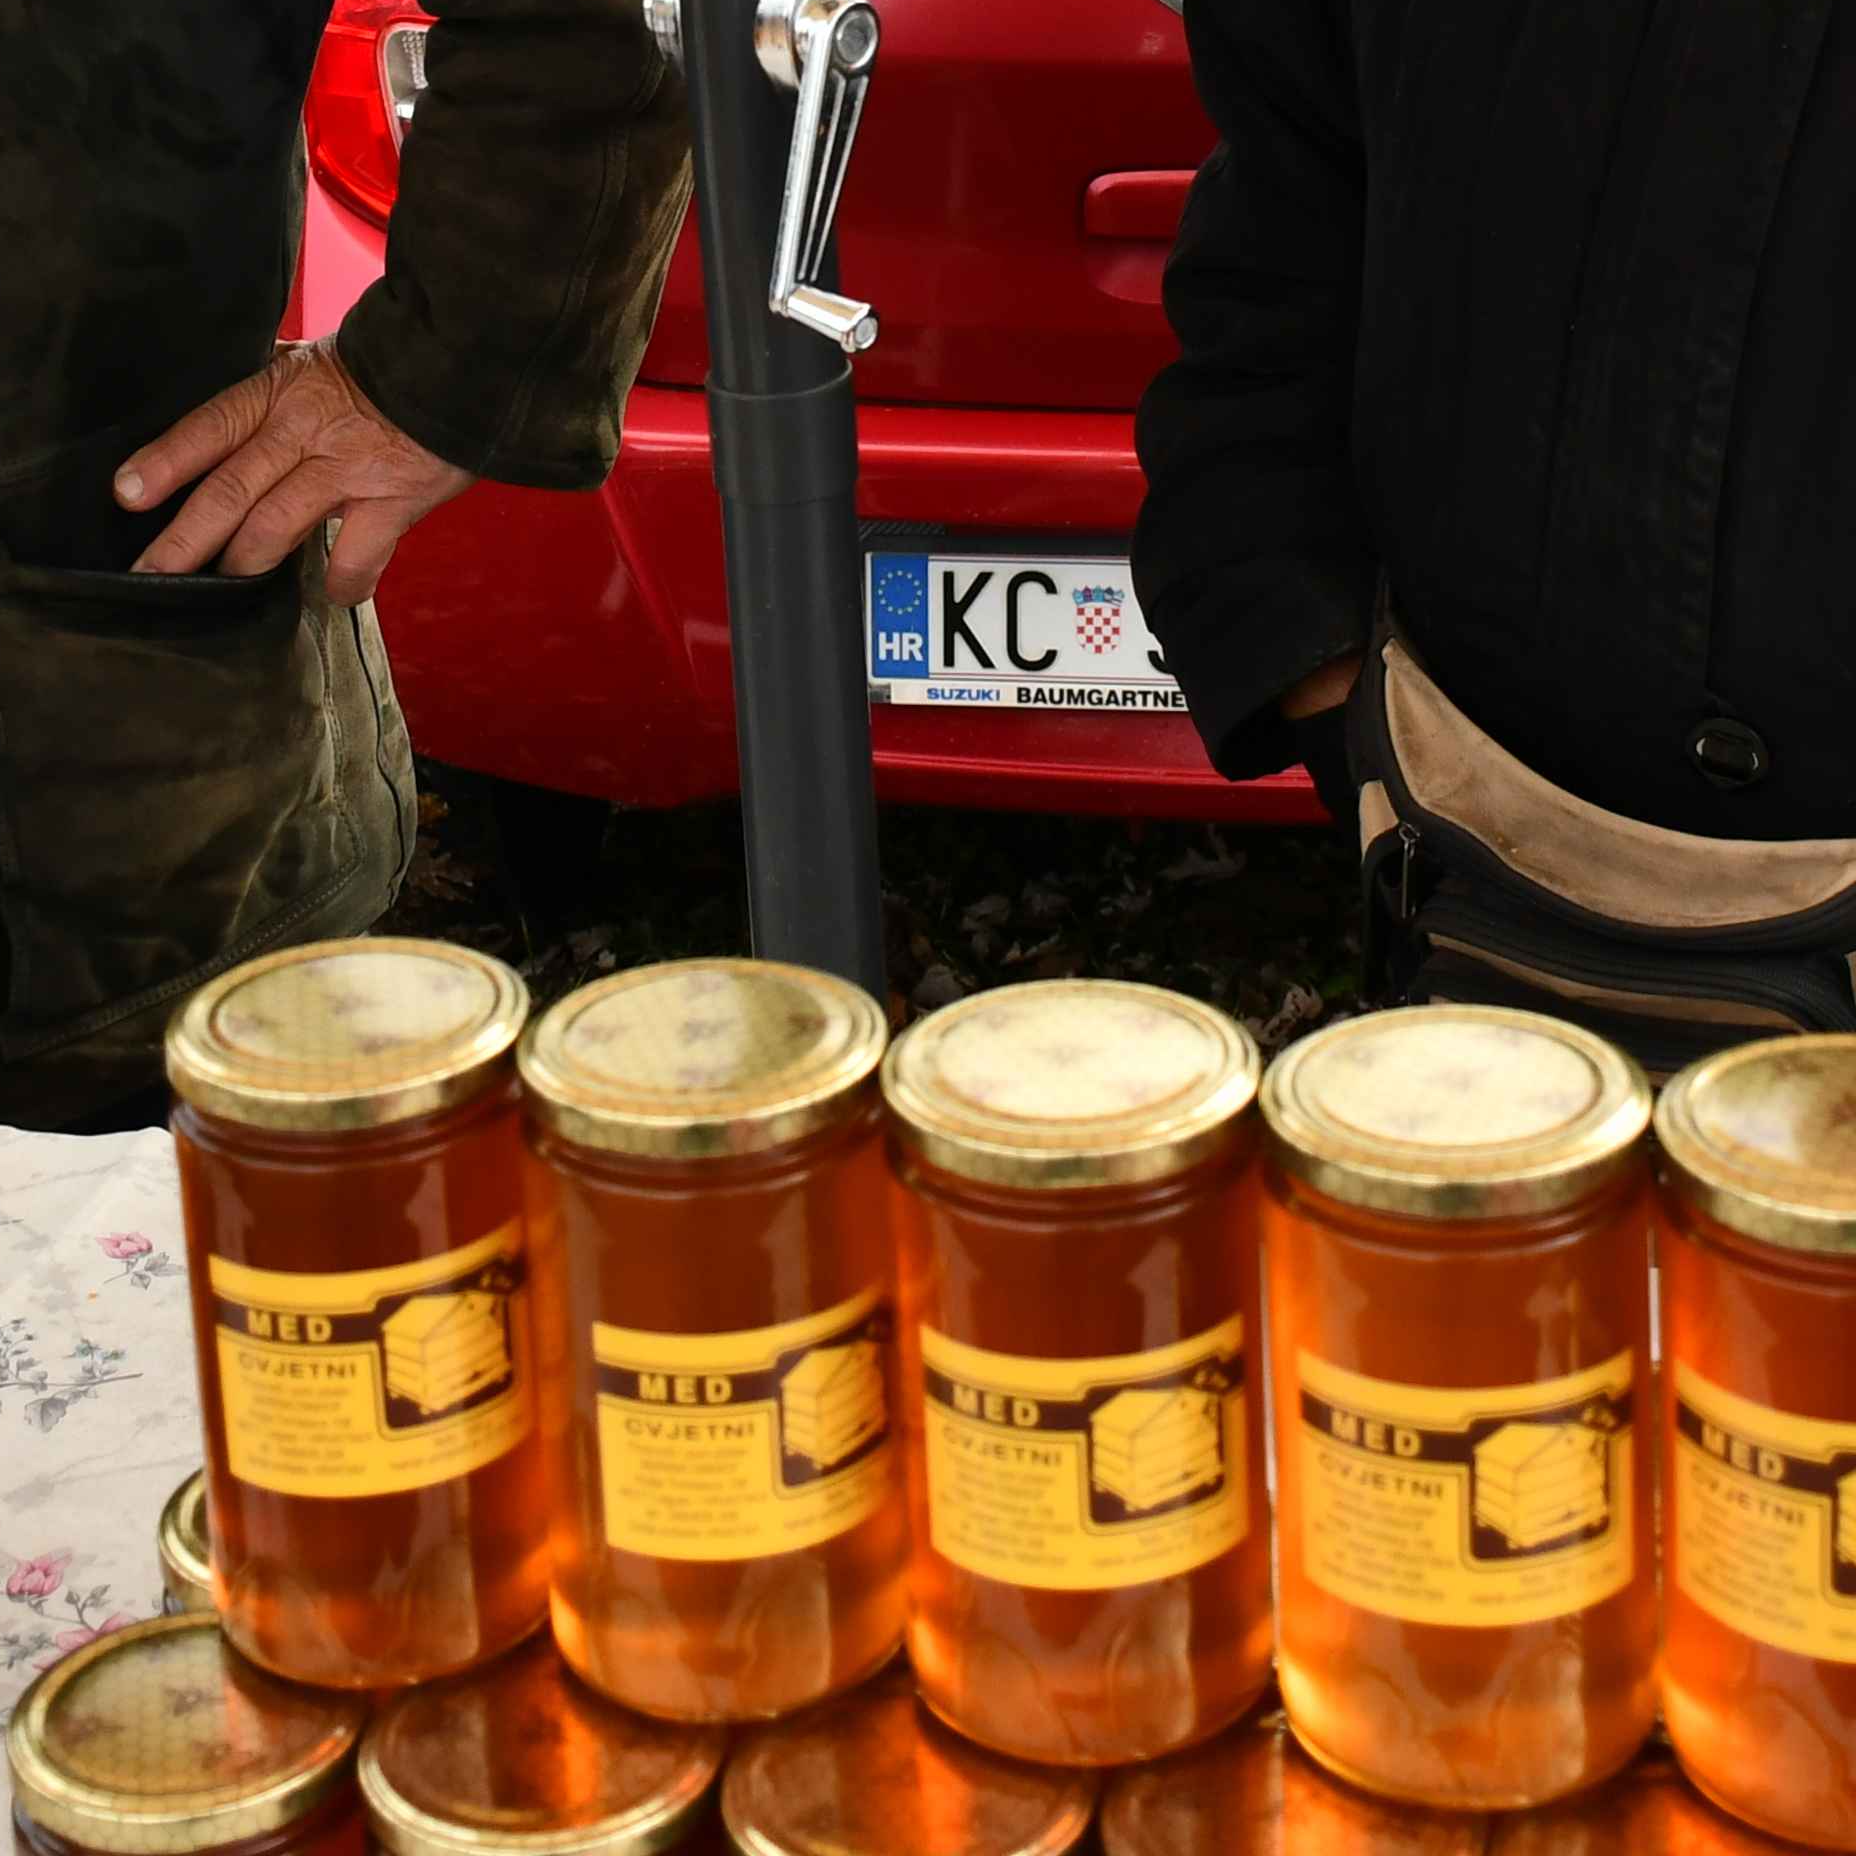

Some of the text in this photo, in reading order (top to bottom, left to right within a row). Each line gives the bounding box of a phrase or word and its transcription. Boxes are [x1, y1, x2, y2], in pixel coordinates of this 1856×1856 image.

[942, 570, 1058, 672] KC
[877, 631, 923, 662] HR
[926, 686, 1001, 702] SUZUKI
[245, 1308, 334, 1343] MED
[637, 1372, 734, 1404] MED
[950, 1384, 1041, 1428] MED
[623, 1417, 757, 1442] CVJETNI
[1329, 1406, 1422, 1459] MED
[1700, 1420, 1785, 1483] MED
